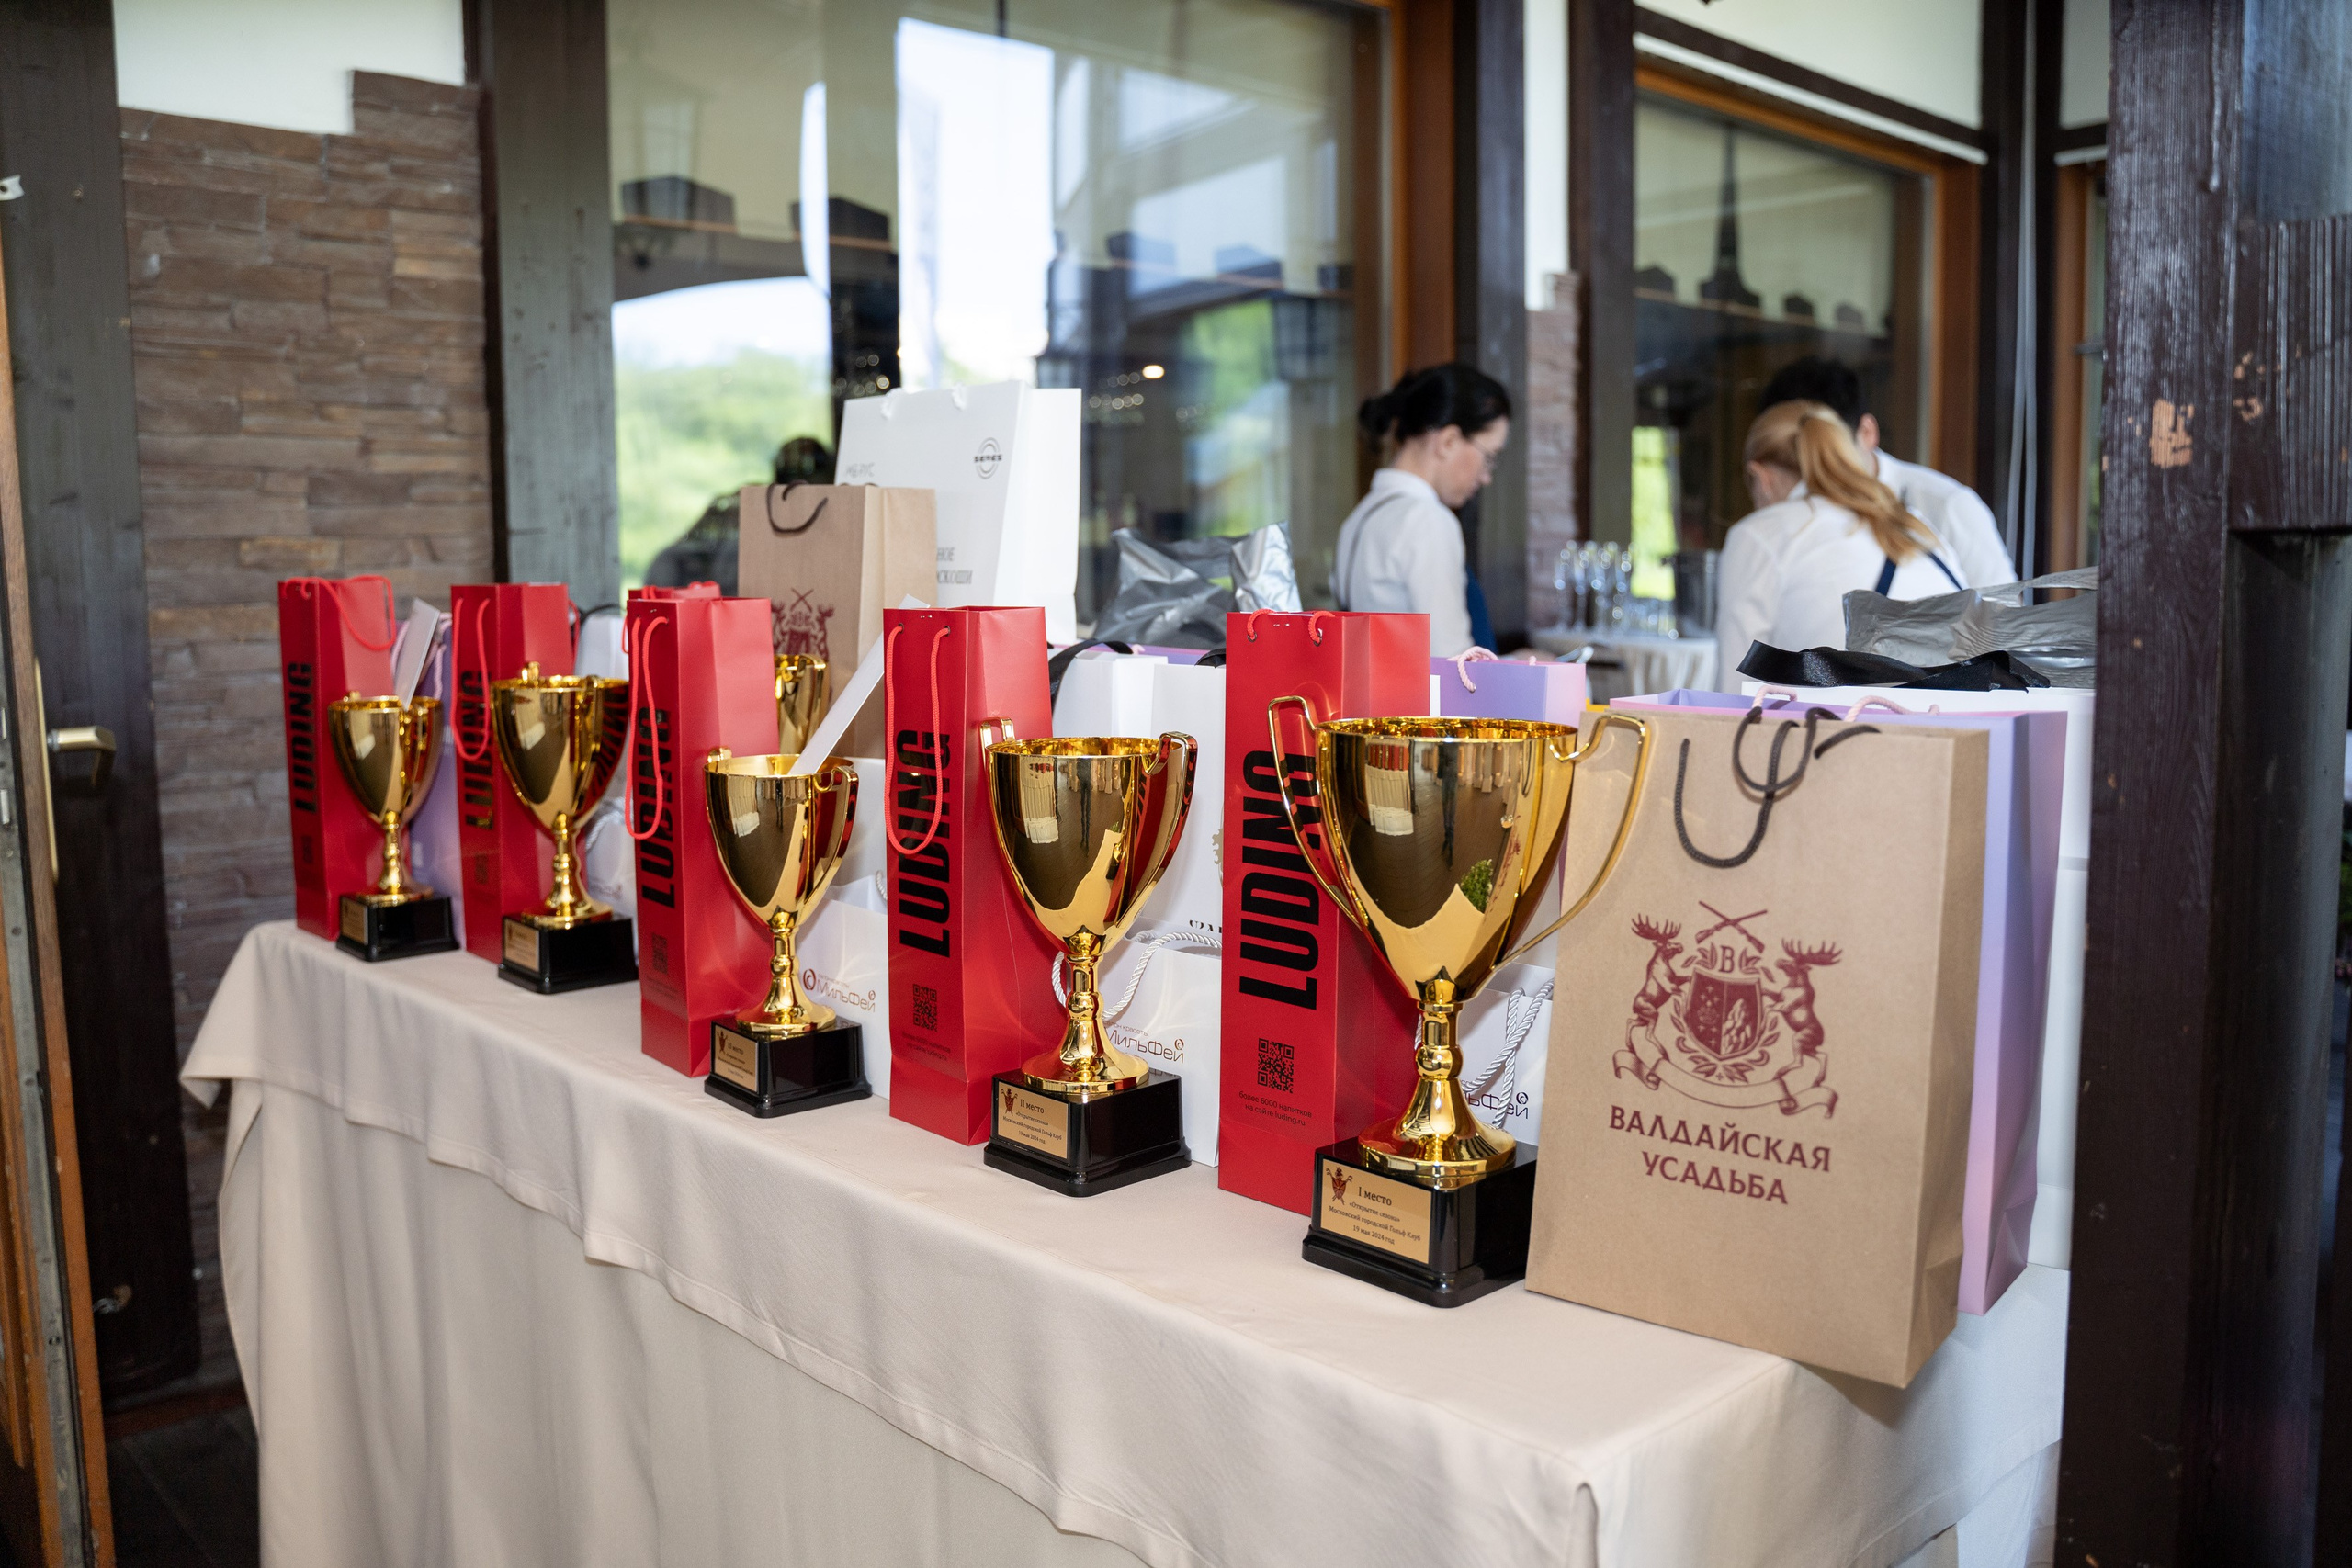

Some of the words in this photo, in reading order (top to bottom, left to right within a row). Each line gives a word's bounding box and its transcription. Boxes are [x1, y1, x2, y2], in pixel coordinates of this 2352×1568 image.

[288, 661, 318, 815] LUDING
[461, 671, 493, 829] LUDING
[639, 706, 675, 908] LUDING
[896, 729, 950, 958] LUDING
[1239, 750, 1321, 1011] LUDING
[1020, 1099, 1025, 1108] II
[1025, 1102, 1045, 1114] место
[1238, 1090, 1260, 1102] более
[1260, 1097, 1278, 1109] 6000
[1279, 1103, 1312, 1118] напитков
[1255, 1106, 1274, 1117] сайте
[1275, 1111, 1306, 1126] luding.ru
[1609, 1104, 1831, 1172] ВАЛДАЙСКАЯ
[1363, 1190, 1392, 1206] место
[1641, 1150, 1789, 1205] УСАДЬБА
[1329, 1205, 1361, 1221] Московский
[1361, 1216, 1389, 1231] городской
[1389, 1224, 1407, 1237] Гольф
[1407, 1231, 1421, 1242] Клуб
[1349, 1201, 1379, 1215] «Открытие
[1352, 1224, 1360, 1233] 19
[1360, 1228, 1371, 1236] мая
[1371, 1231, 1385, 1242] 2024
[1385, 1236, 1395, 1246] год
